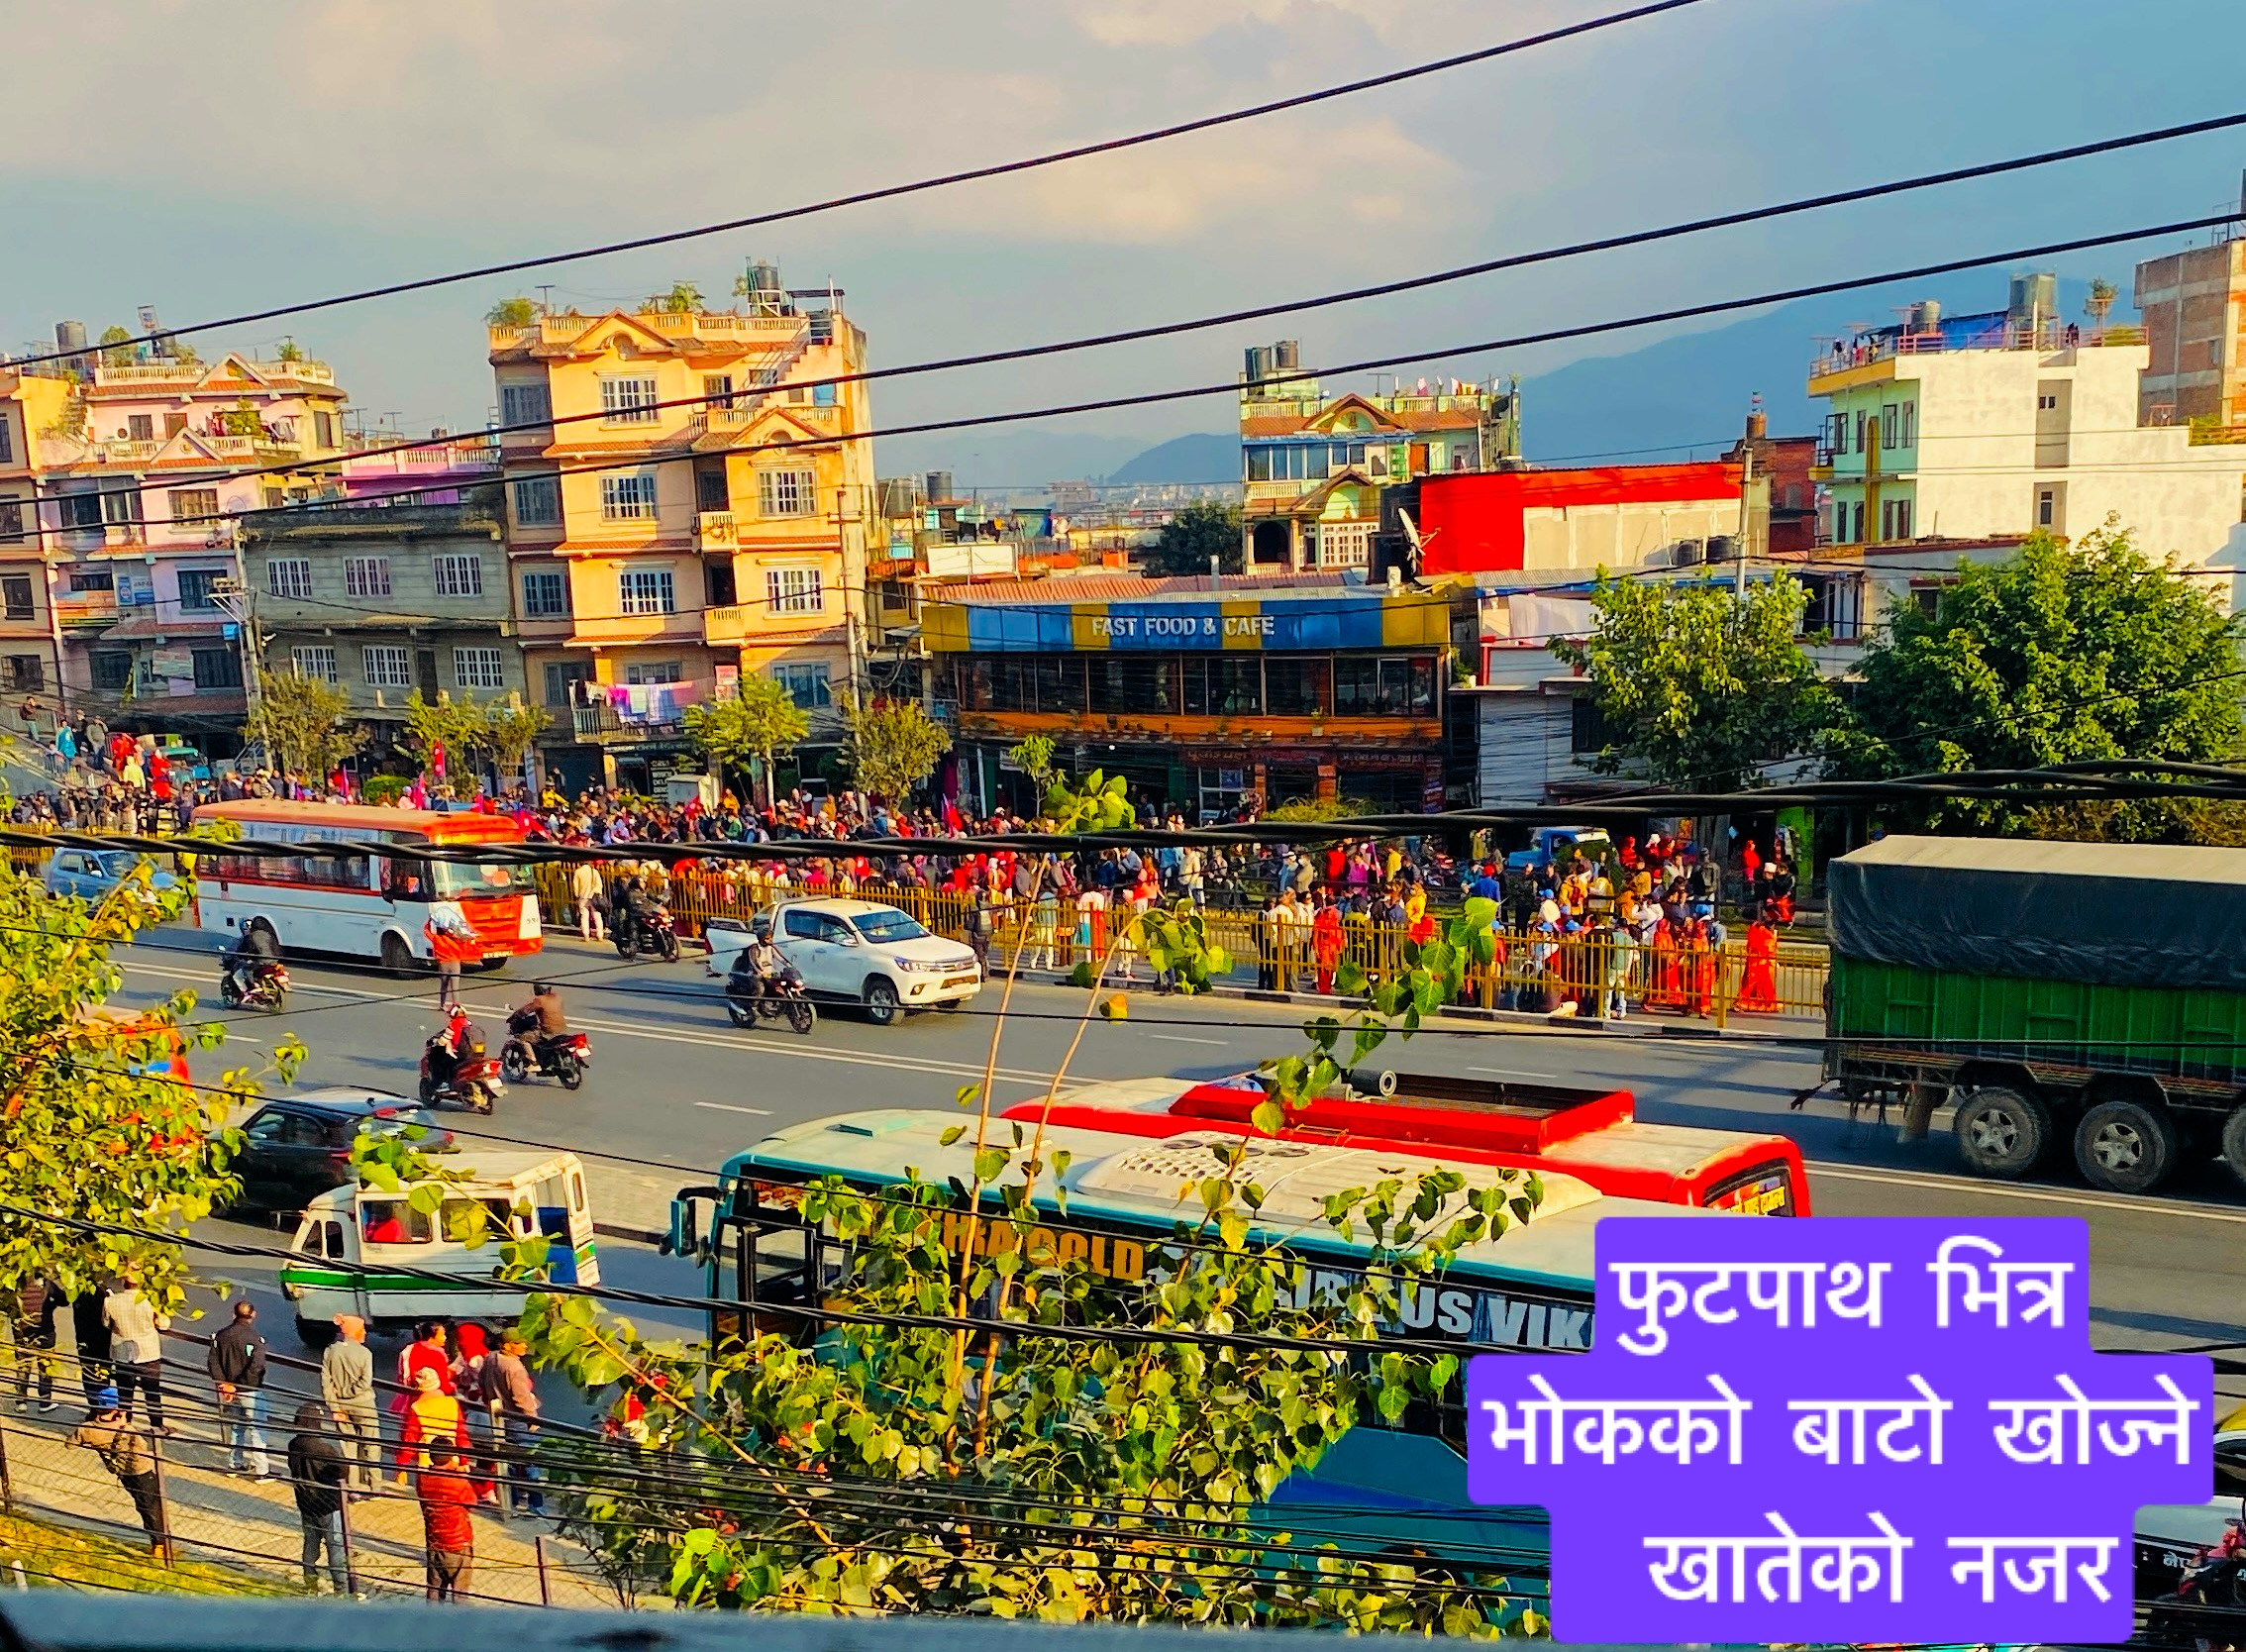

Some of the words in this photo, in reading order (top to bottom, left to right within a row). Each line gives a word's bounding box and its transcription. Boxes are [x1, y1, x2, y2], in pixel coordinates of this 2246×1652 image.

[1091, 617, 1138, 637] FAST
[1145, 617, 1196, 637] FOOD
[1202, 617, 1217, 636] &
[1224, 615, 1276, 637] CAFE
[1027, 1227, 1144, 1282] GOLD
